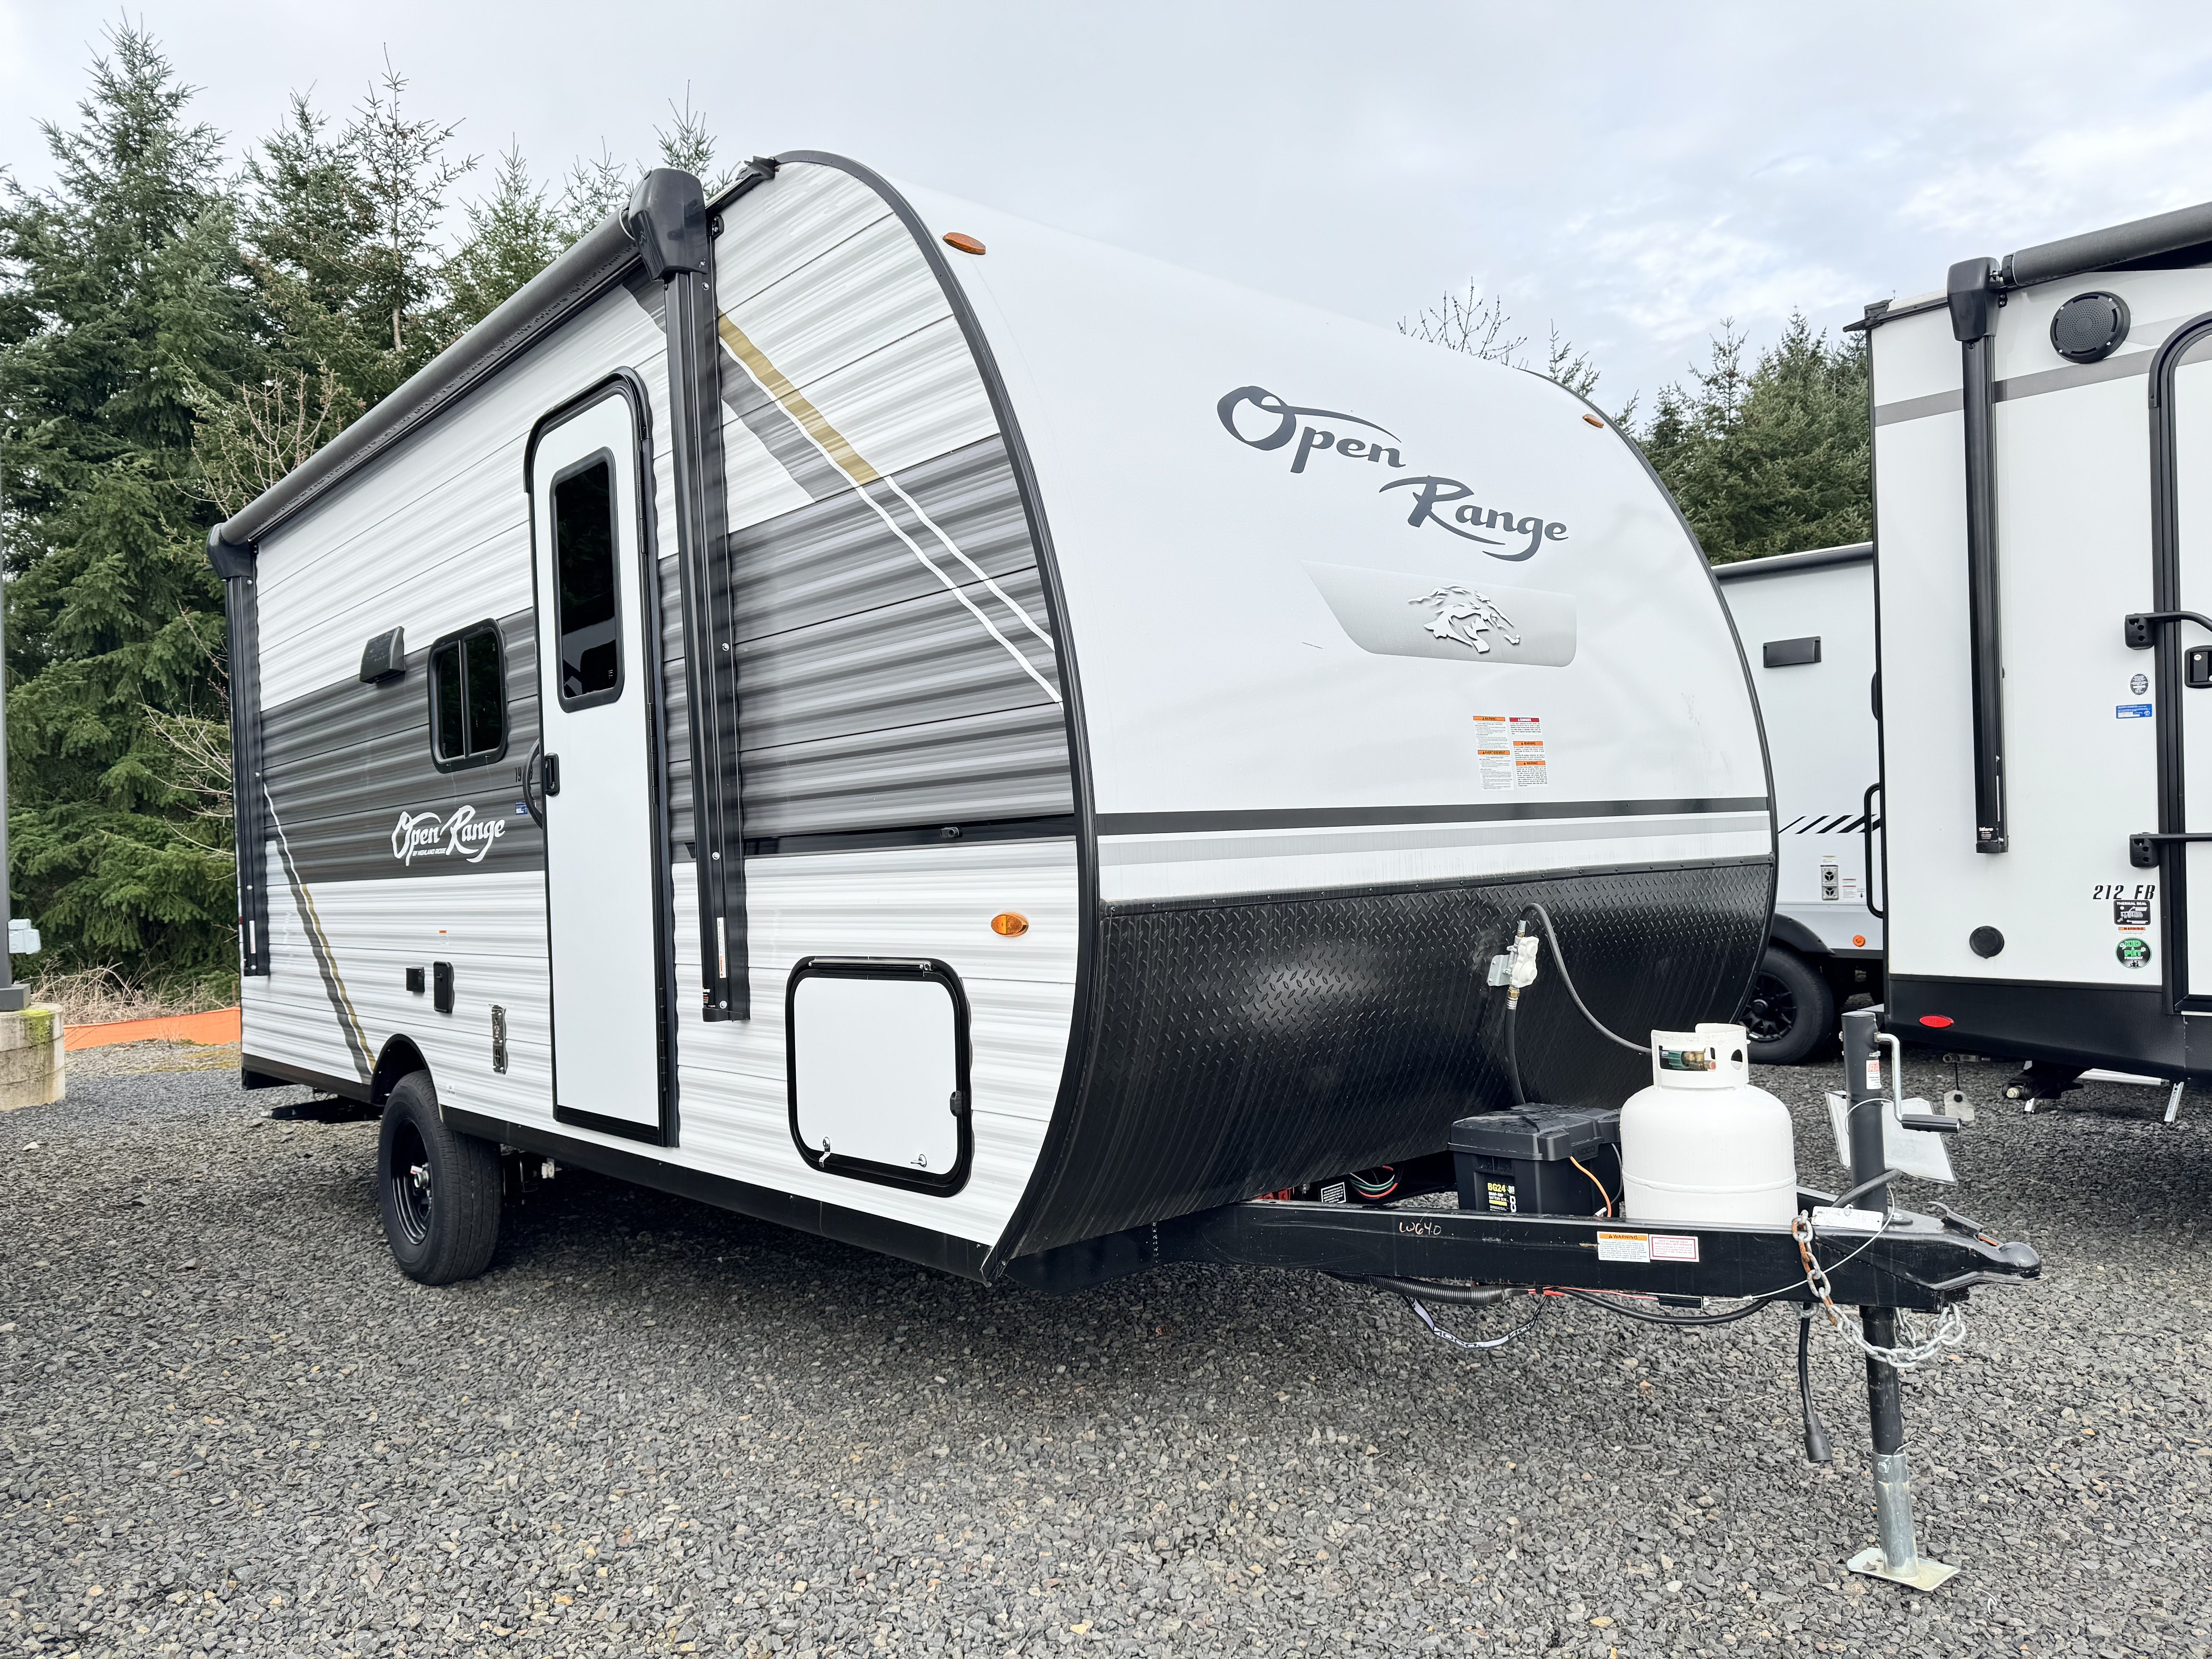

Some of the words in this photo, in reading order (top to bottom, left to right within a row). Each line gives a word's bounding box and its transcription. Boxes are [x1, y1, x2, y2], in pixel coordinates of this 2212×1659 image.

[1217, 386, 1406, 474] Open
[1379, 475, 1568, 562] Range
[392, 811, 441, 866] Open
[440, 805, 505, 863] Range
[2093, 885, 2124, 900] 212
[2134, 884, 2155, 900] FB
[1577, 1146, 1595, 1156] NOCO
[1487, 1182, 1506, 1193] BG24
